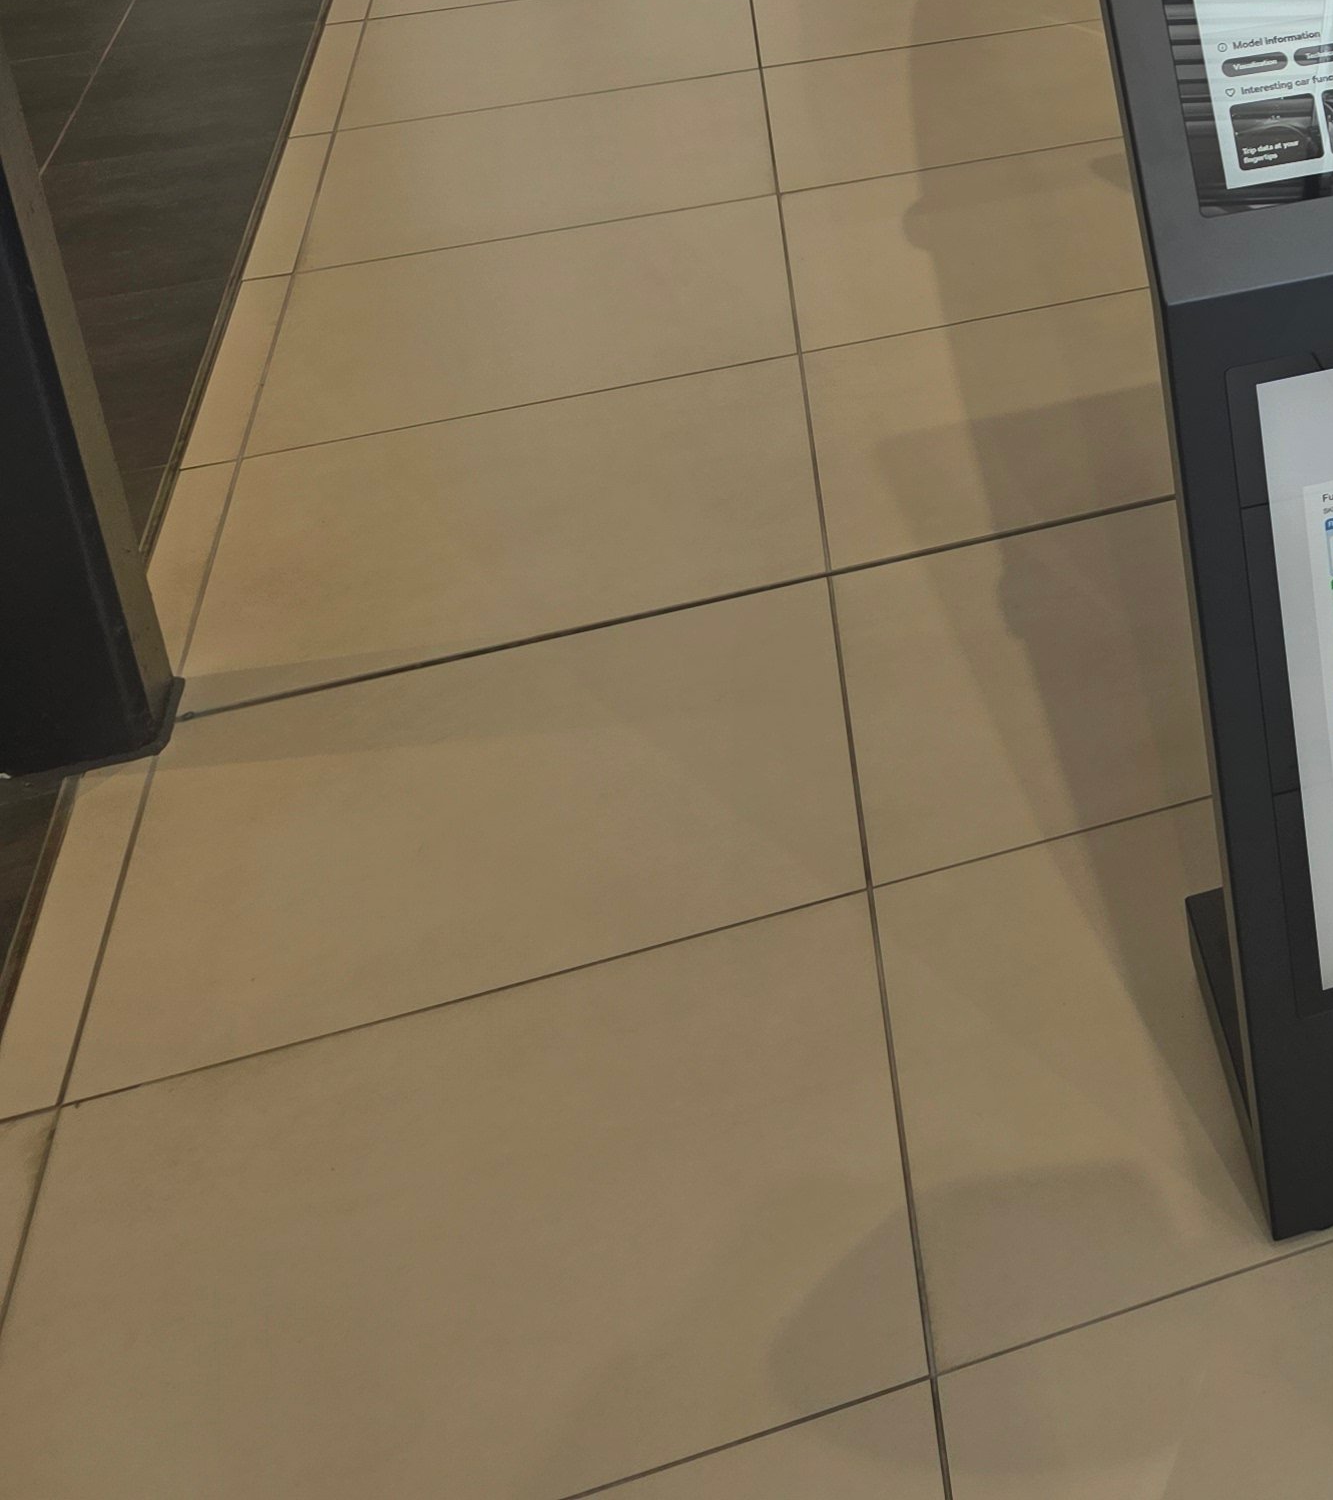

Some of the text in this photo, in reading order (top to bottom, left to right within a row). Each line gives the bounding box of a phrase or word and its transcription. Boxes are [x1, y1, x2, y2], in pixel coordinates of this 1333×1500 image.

[1231, 28, 1321, 50] Model information
[1239, 78, 1293, 97] Interesting
[1294, 77, 1310, 87] car
[1241, 138, 1300, 156] Trip data at your
[1242, 150, 1279, 165] fingertips
